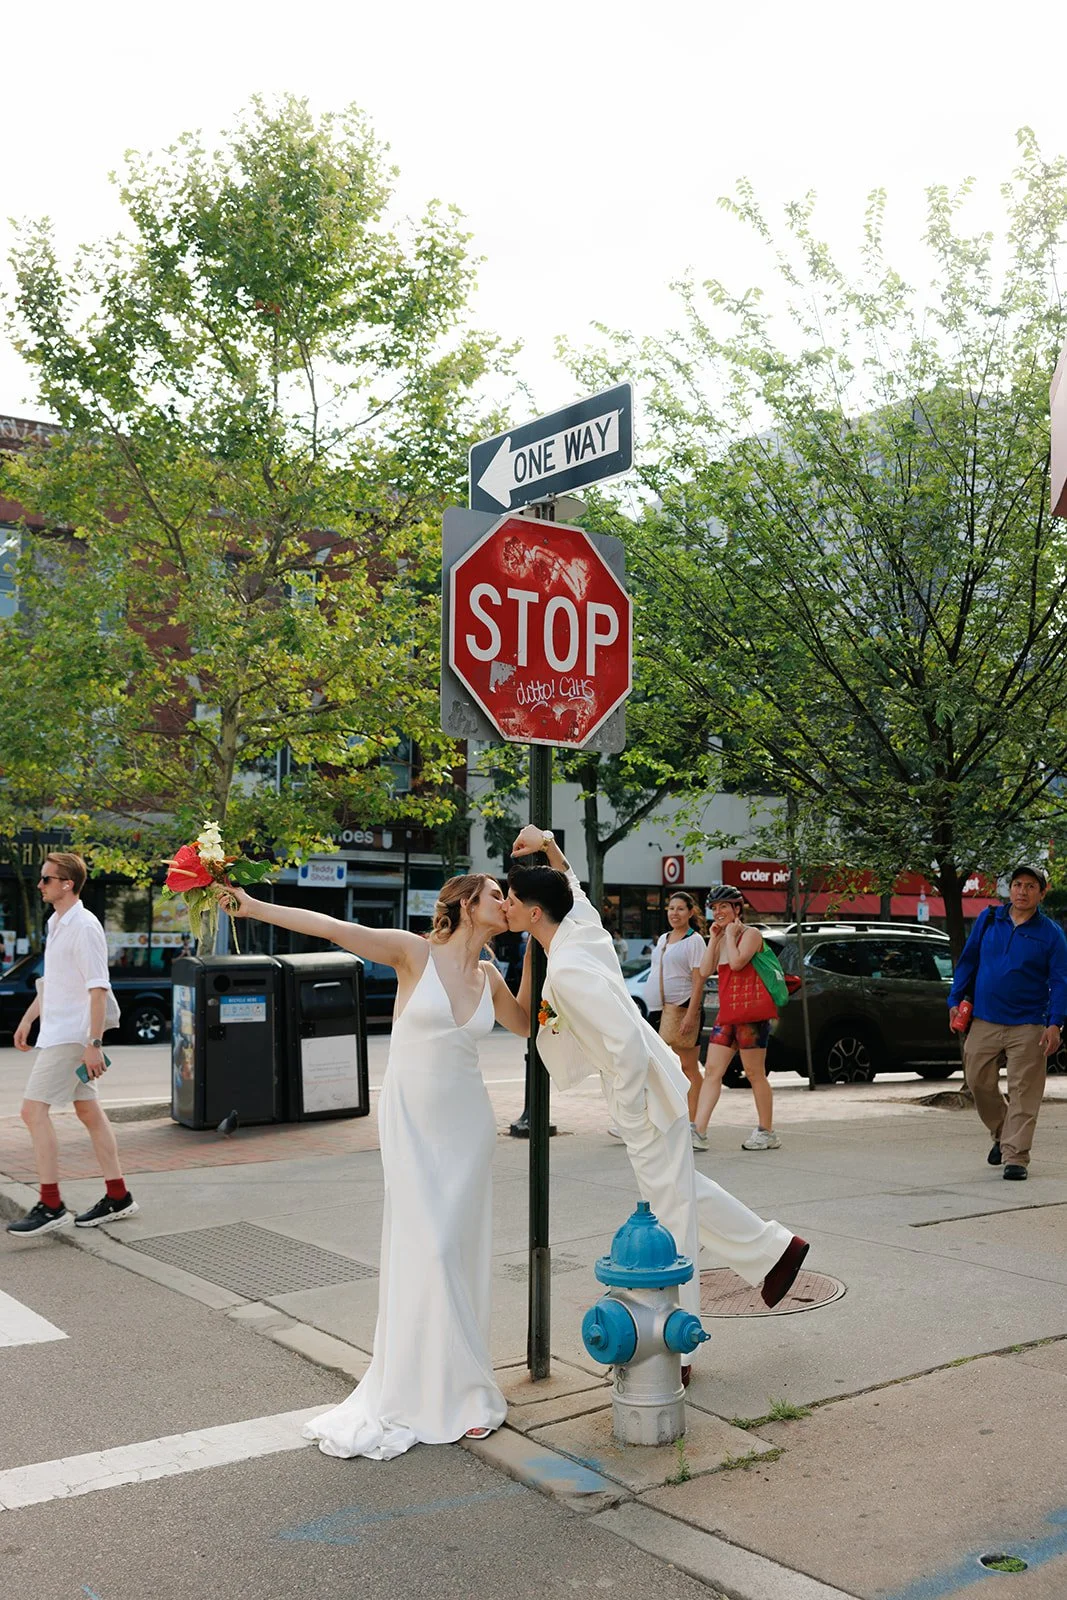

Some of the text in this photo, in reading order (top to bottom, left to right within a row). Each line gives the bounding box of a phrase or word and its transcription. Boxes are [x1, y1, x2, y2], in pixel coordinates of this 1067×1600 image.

[514, 416, 613, 483] ONE WAY
[465, 582, 620, 677] STOP
[311, 864, 334, 875] Teddy
[740, 869, 770, 882] order
[310, 873, 336, 882] Shoes
